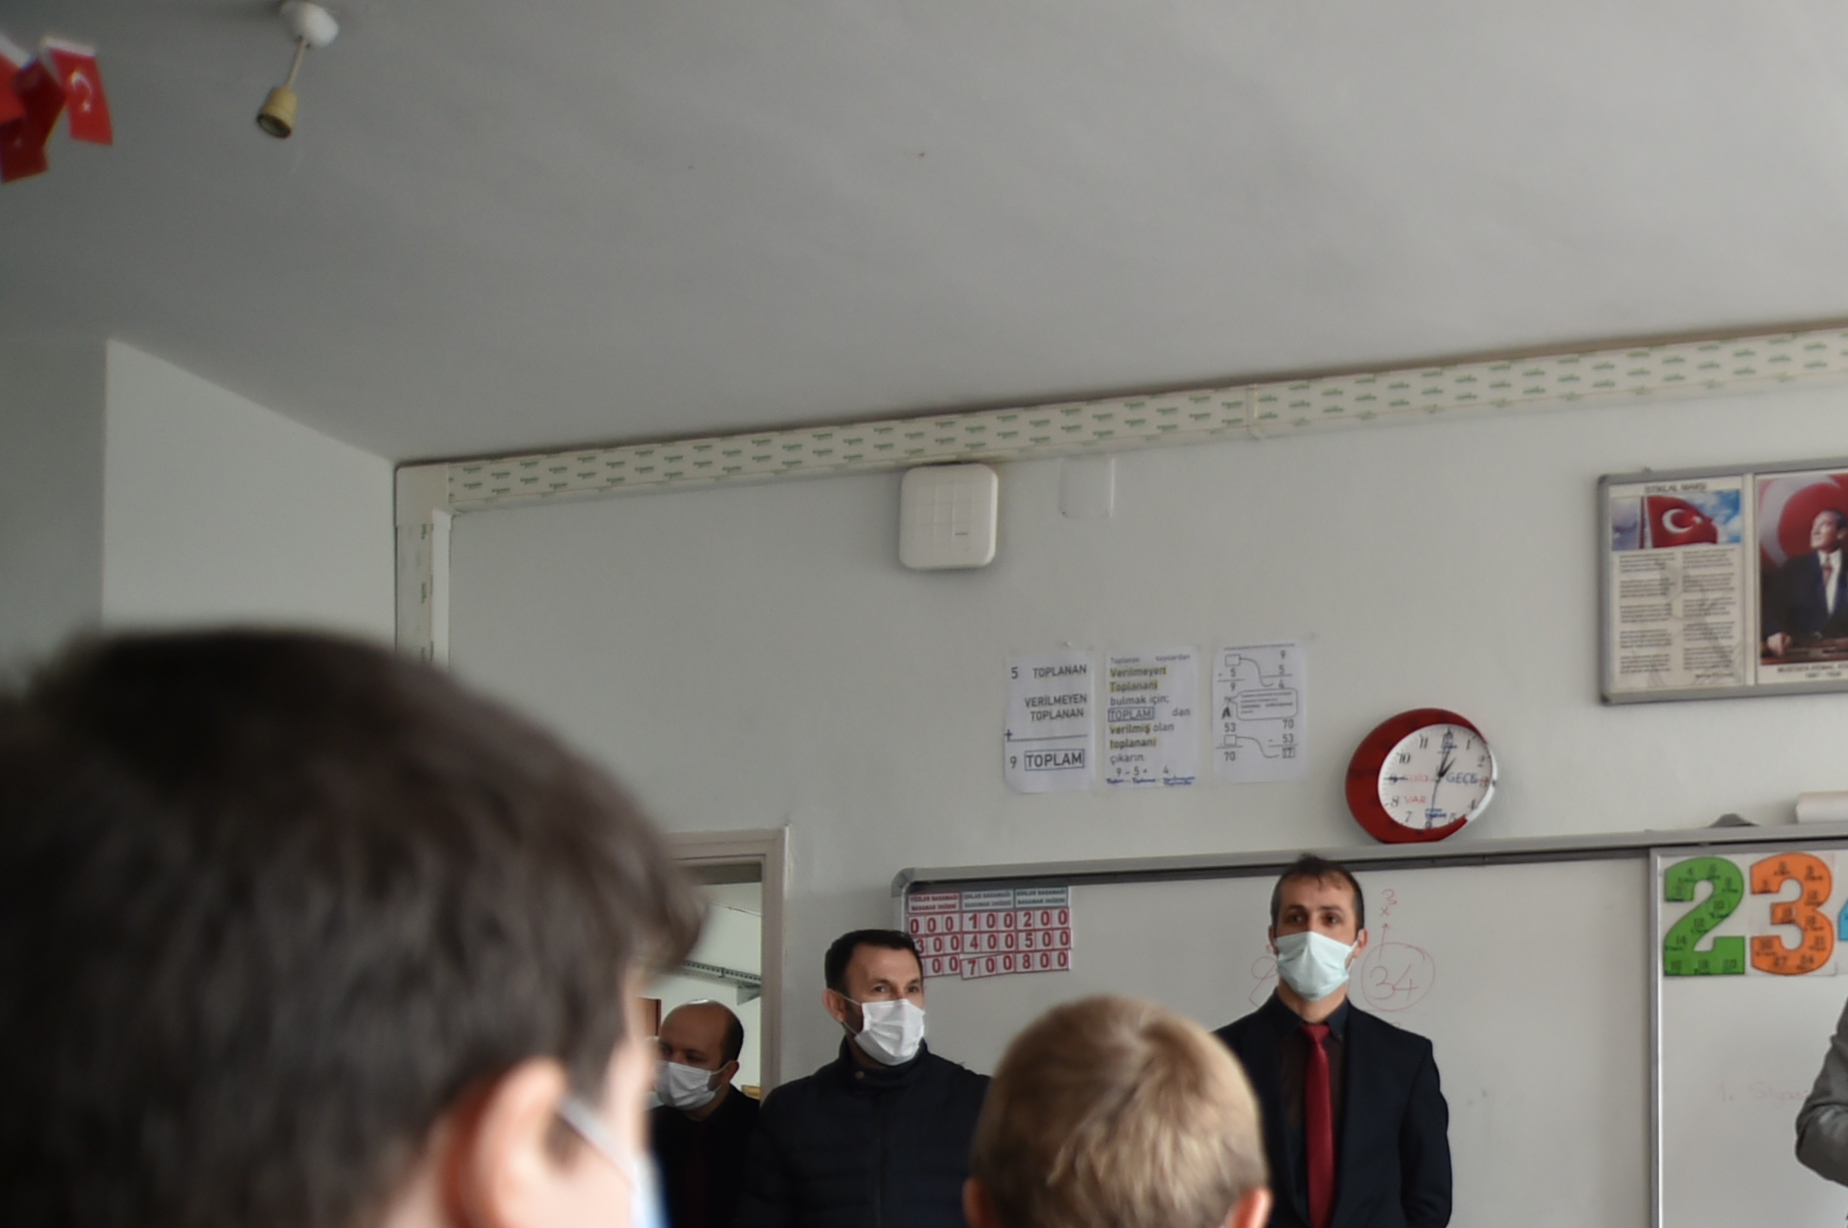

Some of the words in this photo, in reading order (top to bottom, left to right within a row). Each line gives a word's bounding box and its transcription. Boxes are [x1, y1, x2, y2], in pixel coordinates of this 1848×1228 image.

[1011, 667, 1019, 679] 5
[1033, 664, 1087, 678] TOPLANAN
[1025, 693, 1087, 708] VERİLMEYEN
[1110, 695, 1146, 706] bulmak
[1030, 708, 1084, 722] TOPLANAN
[1110, 709, 1151, 720] TOPLAM
[1172, 707, 1190, 717] dan
[1153, 722, 1174, 732] olan
[1225, 722, 1236, 733] 53
[1283, 719, 1294, 729] 70
[1283, 733, 1294, 743] 53
[1010, 755, 1017, 768] 9
[1026, 752, 1082, 767] TOPLAM
[1224, 751, 1236, 761] 70
[1396, 752, 1411, 764] 10
[1134, 766, 1139, 777] 5
[1390, 796, 1399, 807] 8
[1404, 796, 1427, 804] VAR
[1663, 856, 1745, 976] 2
[1750, 852, 1834, 975] 3
[1369, 964, 1419, 1001] 34
